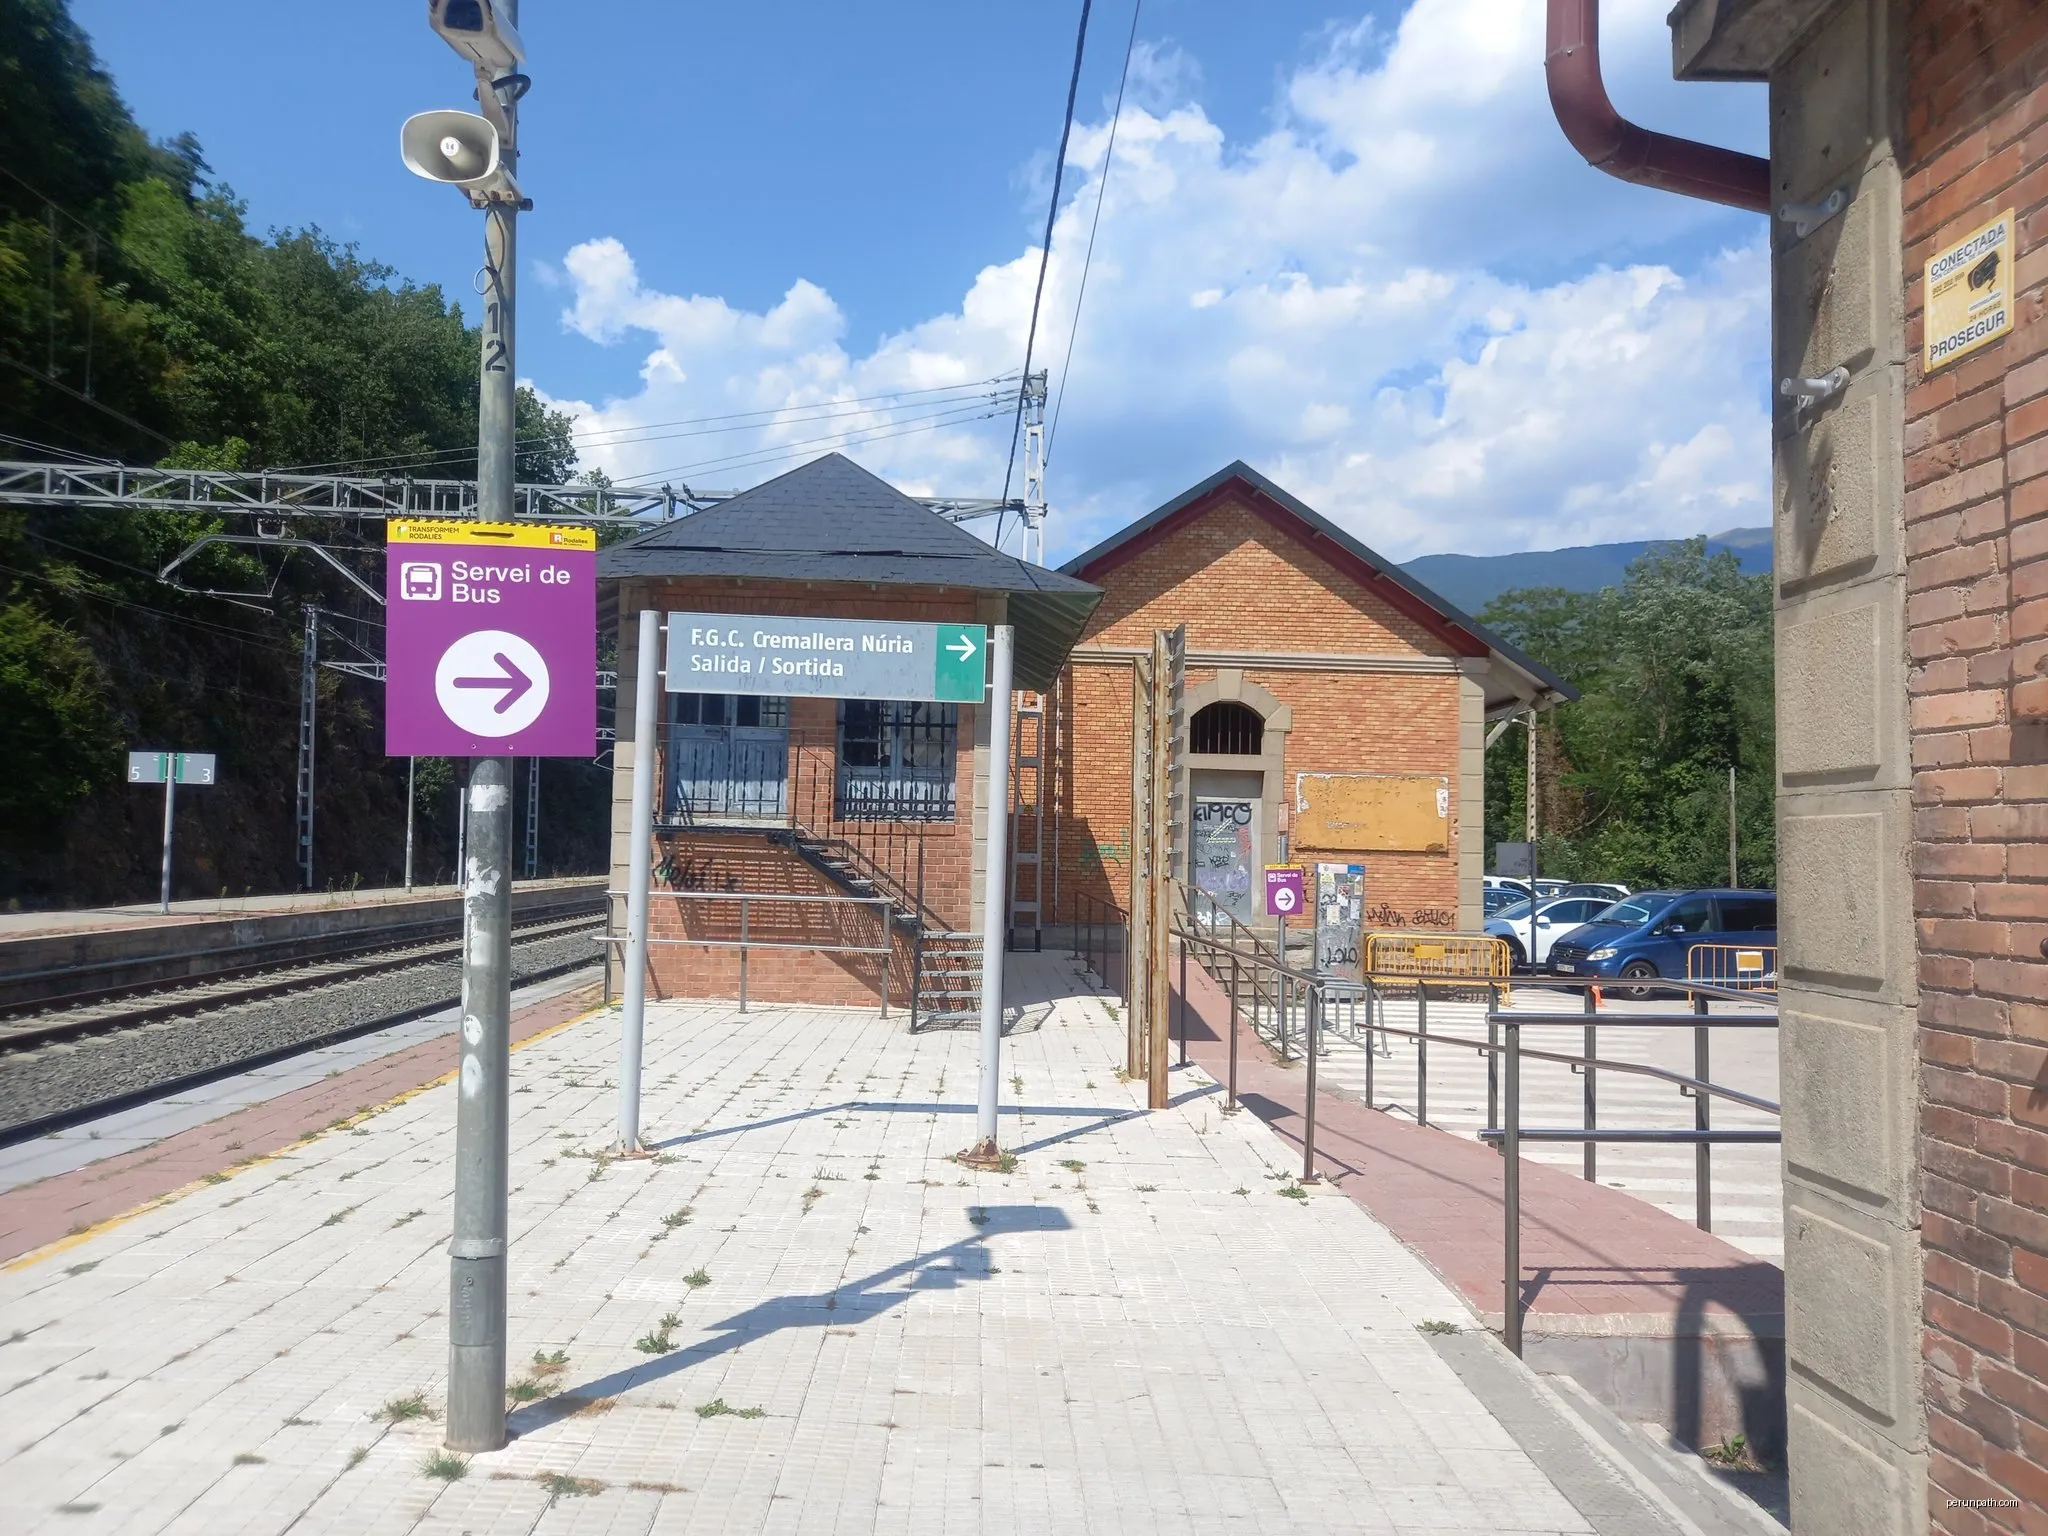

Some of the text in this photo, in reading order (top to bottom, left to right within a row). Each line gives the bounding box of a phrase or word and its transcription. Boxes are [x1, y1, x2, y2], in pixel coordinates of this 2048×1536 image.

[1931, 223, 2005, 276] CONECTADA
[1930, 310, 2005, 361] PROSEGUR
[409, 526, 460, 534] TRANSFORMEM
[451, 560, 571, 585] Servei de
[452, 583, 501, 604] Bus
[691, 628, 914, 654] F.G.C. Cremallera Núria
[690, 654, 844, 677] Salida / Sortida
[130, 766, 141, 781] 5
[201, 768, 212, 782] 3
